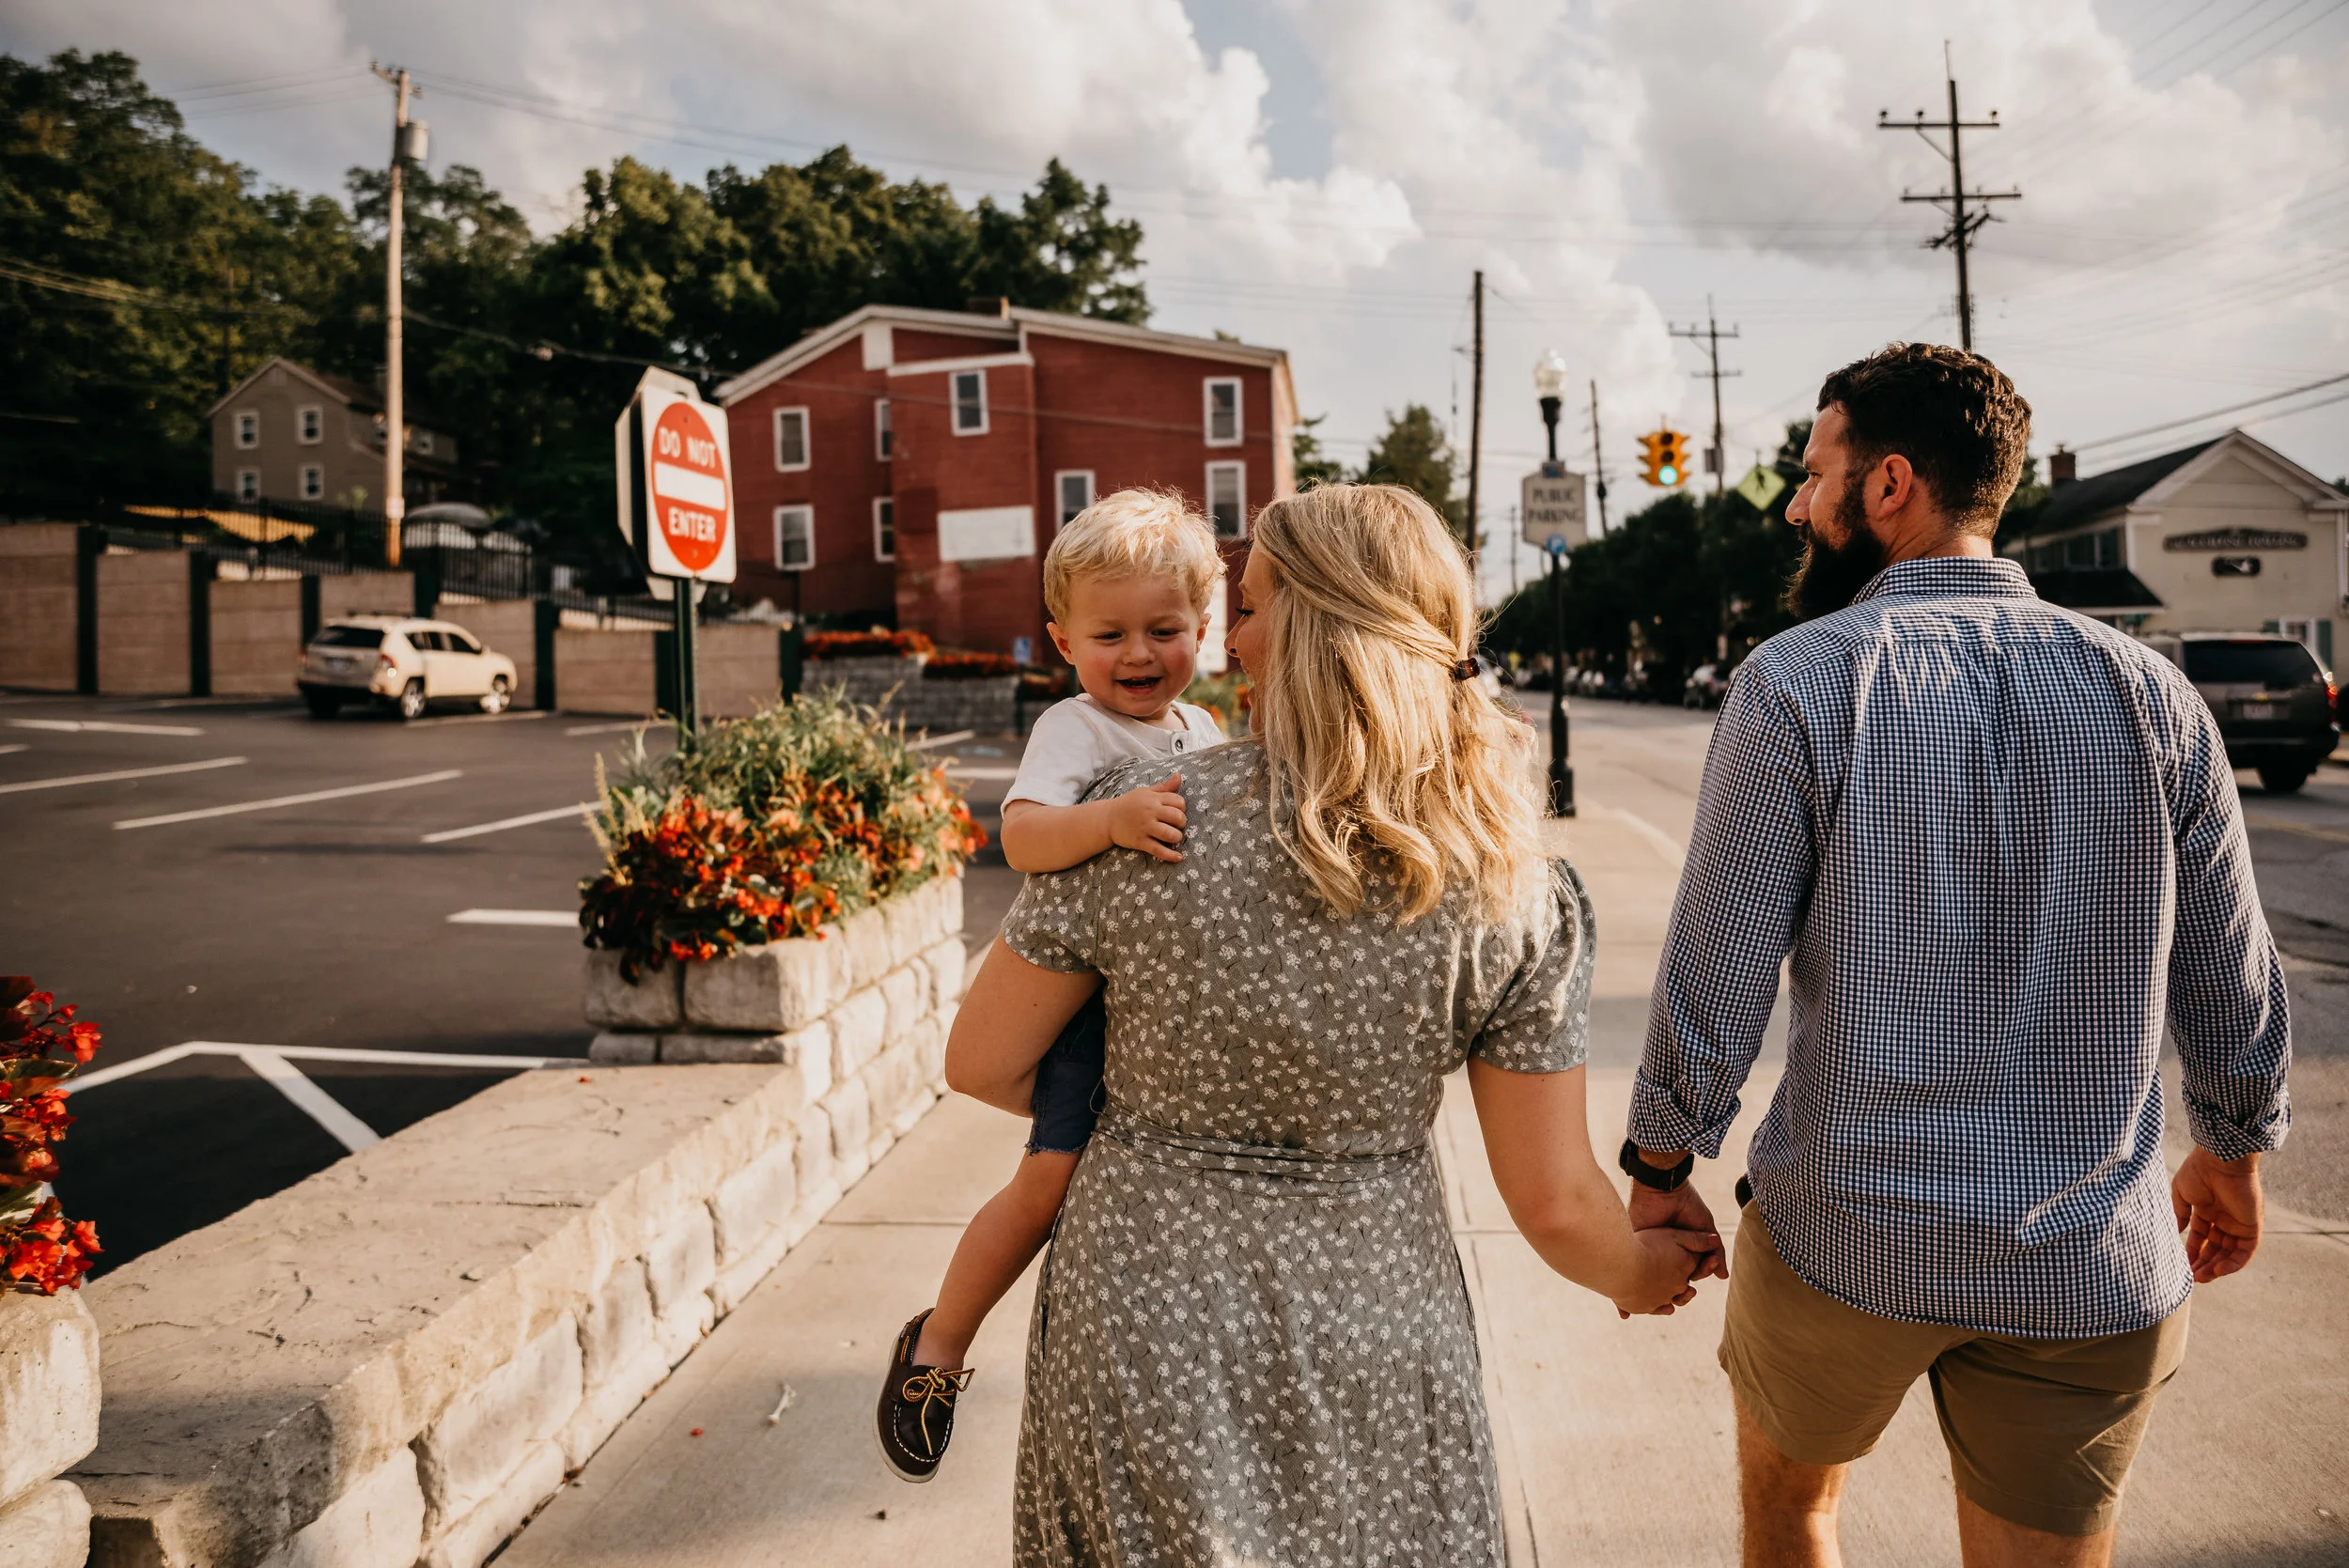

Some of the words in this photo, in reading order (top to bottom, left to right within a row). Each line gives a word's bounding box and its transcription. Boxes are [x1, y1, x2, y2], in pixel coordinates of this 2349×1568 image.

[659, 427, 681, 458] DO
[687, 435, 716, 469] NOT
[1532, 489, 1577, 503] PUBLIC
[668, 506, 717, 543] ENTER
[1528, 508, 1583, 523] PARKING
